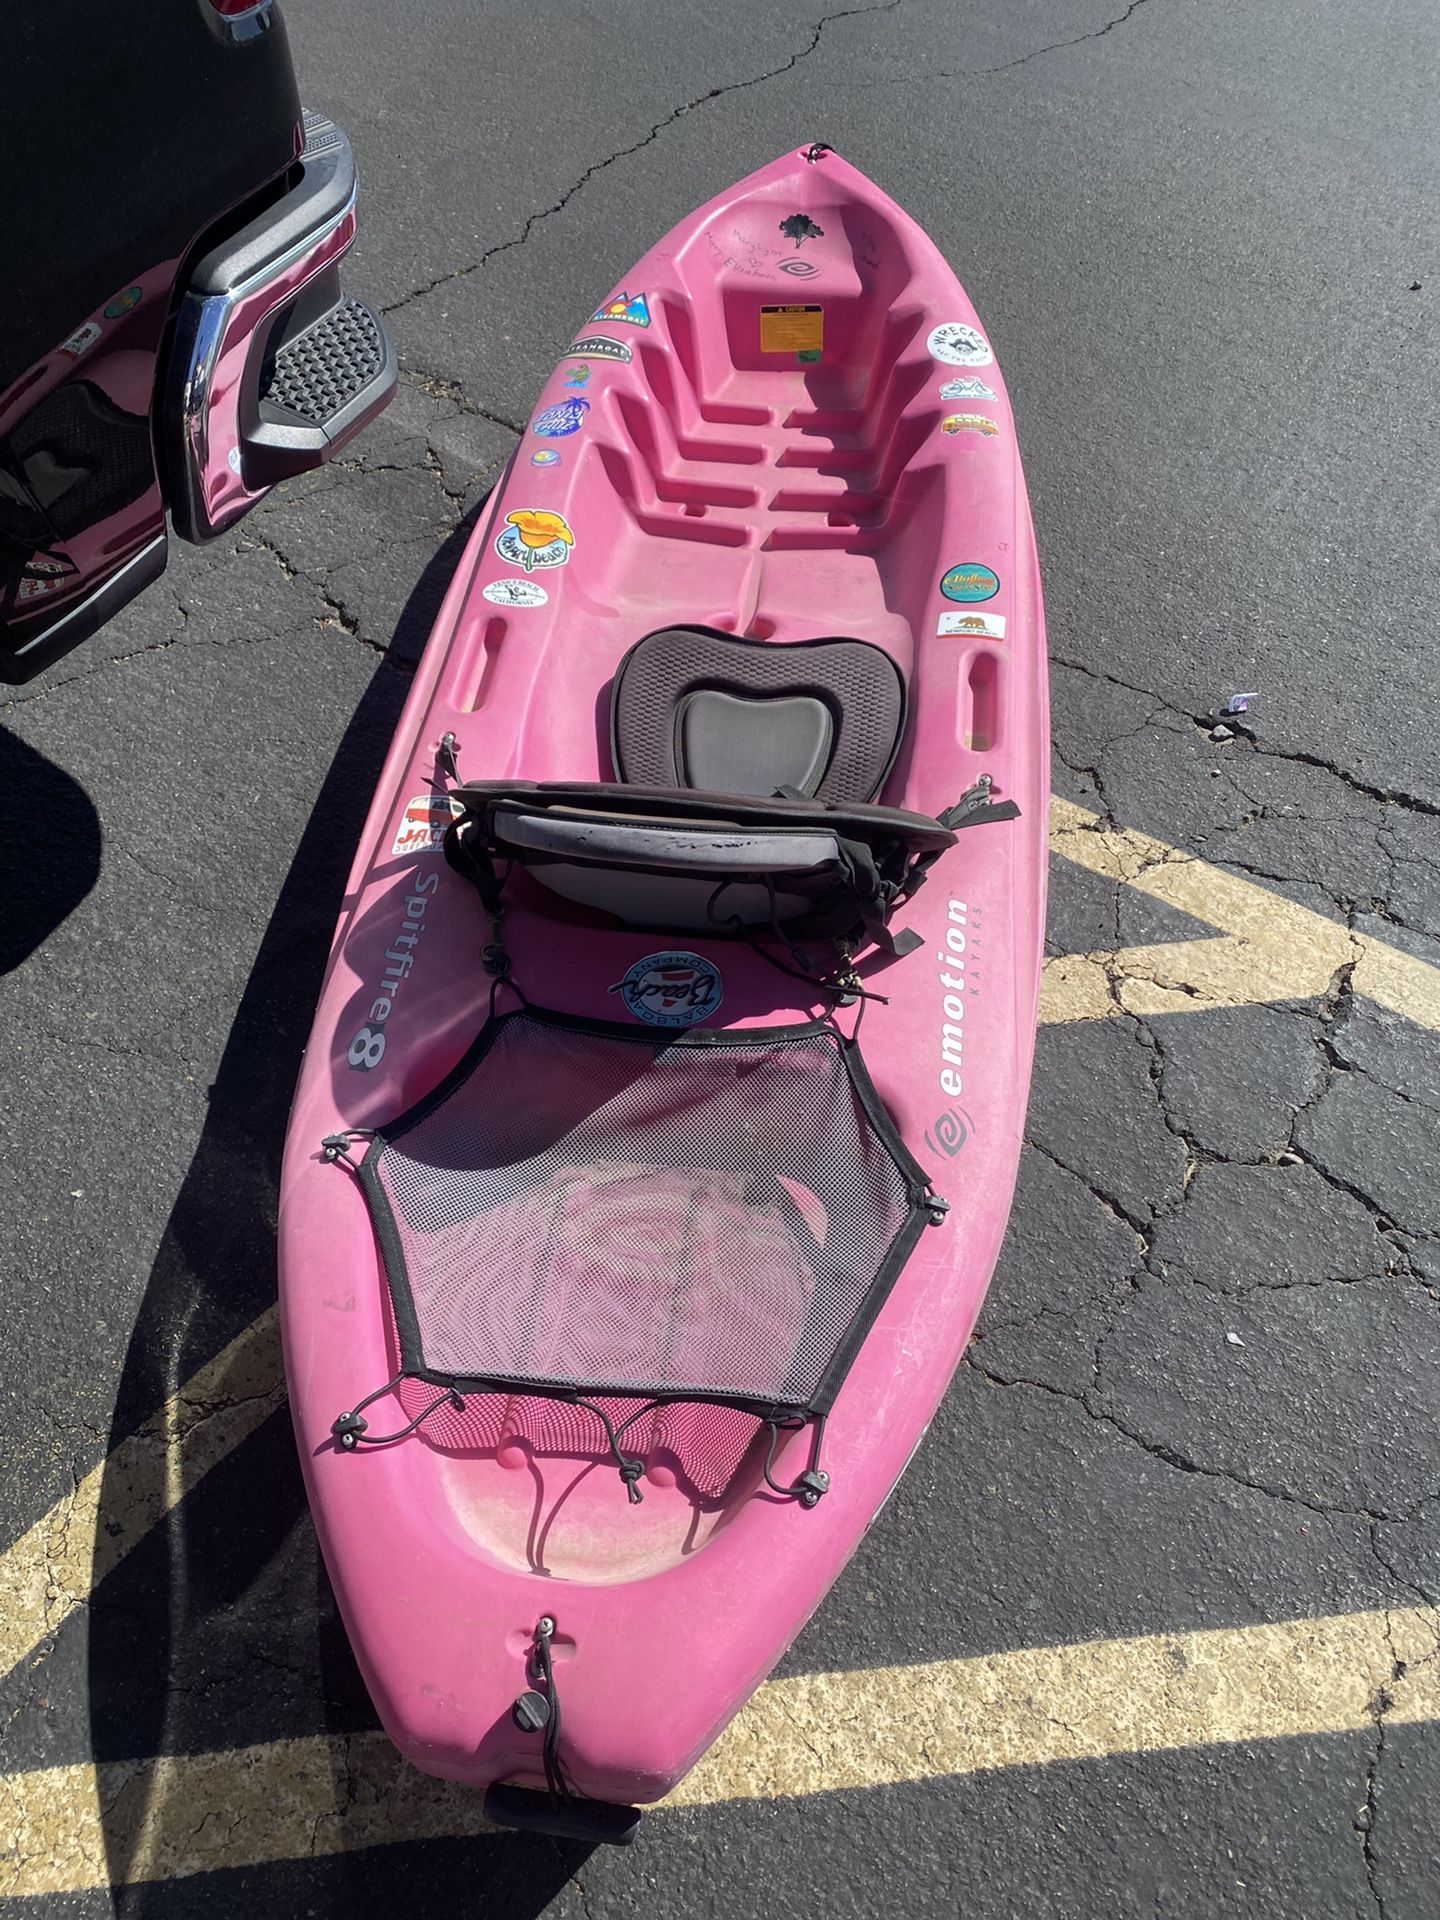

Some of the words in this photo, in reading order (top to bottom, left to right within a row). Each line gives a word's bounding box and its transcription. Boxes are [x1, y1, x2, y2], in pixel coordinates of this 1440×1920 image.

[368, 871, 440, 1022] Spitfire
[634, 956, 711, 978] COMPANY
[969, 906, 983, 997] KAYAKS
[607, 973, 717, 1007] Beach
[937, 898, 969, 1098] emotion
[634, 1001, 708, 1025] BALBOA
[347, 1026, 386, 1069] 8
